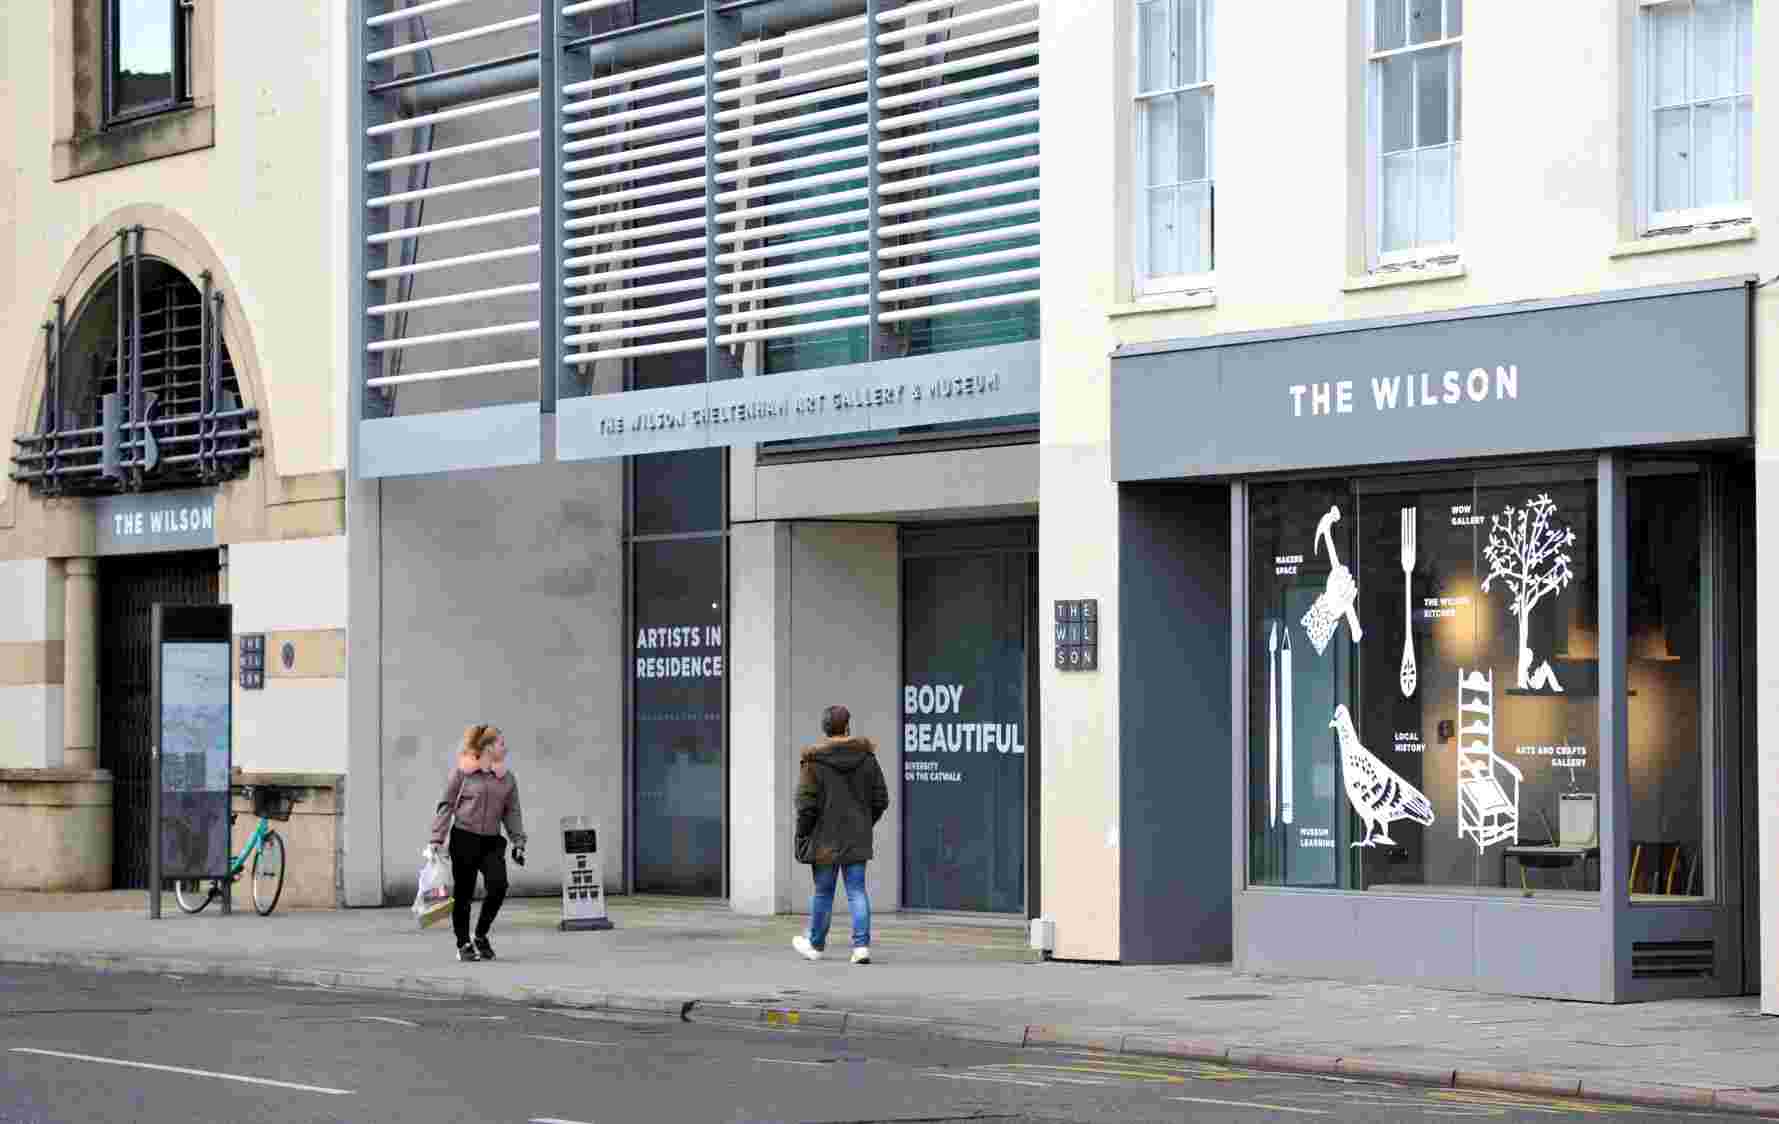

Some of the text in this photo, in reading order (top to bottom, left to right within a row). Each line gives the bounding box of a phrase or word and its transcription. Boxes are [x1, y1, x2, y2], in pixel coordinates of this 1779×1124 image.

[600, 415, 624, 435] THE
[631, 409, 686, 432] WILSON
[692, 399, 789, 426] CHELTENHAM
[794, 393, 825, 415] ART
[832, 383, 905, 410] GALLERY
[927, 373, 1000, 399] MUSEUM
[1289, 364, 1518, 417] THE WILSON
[114, 507, 213, 536] THE WILSON
[637, 626, 722, 649] ARTISTS IN
[636, 656, 722, 679] RESIDENCE
[904, 684, 964, 714] BODY
[904, 722, 1025, 754] BEAUTIFUL
[1394, 732, 1419, 741] LOCAL
